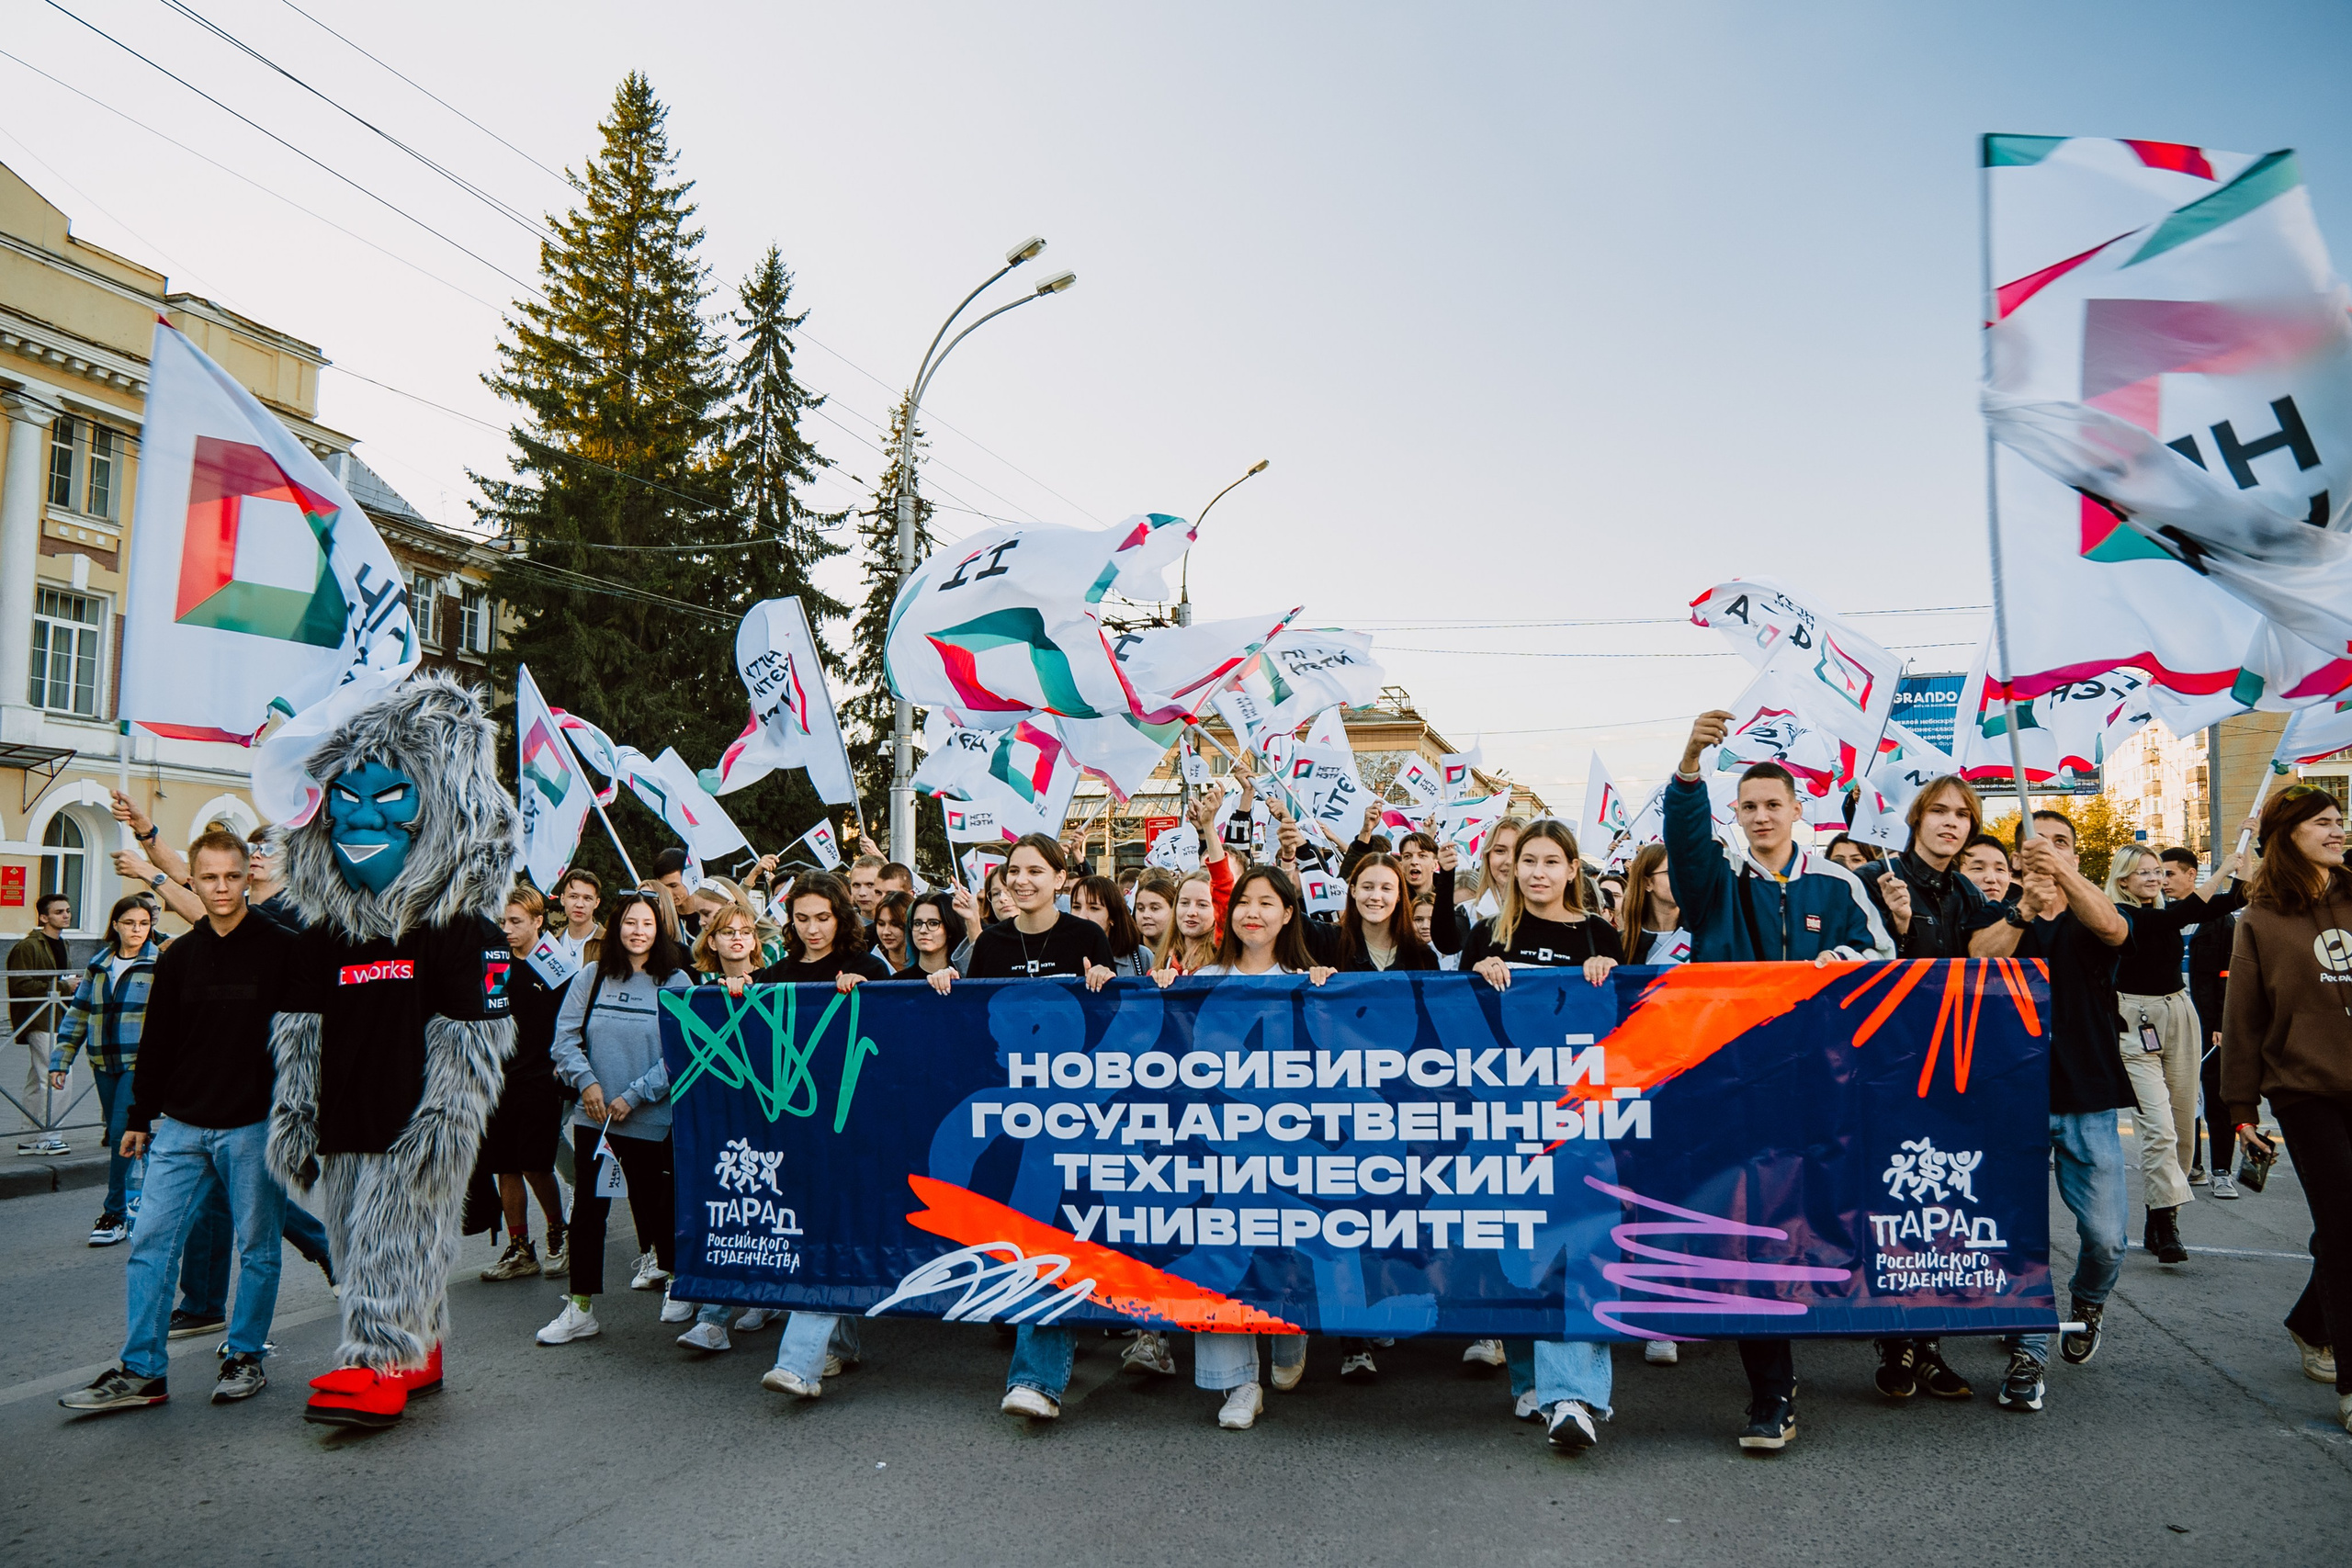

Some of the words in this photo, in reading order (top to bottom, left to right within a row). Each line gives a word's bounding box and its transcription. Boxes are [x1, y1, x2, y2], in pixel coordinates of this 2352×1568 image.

[1893, 691, 1958, 705] GRANDO
[1419, 782, 1436, 796] НЭТИ
[1422, 778, 1439, 792] НГТУ
[969, 818, 993, 827] НЭТИ
[485, 950, 511, 960] NSTU
[354, 960, 414, 984] works.
[546, 961, 562, 978] НЭТИ
[550, 957, 566, 974] НГТУ
[1008, 1033, 1605, 1089] НОВОСИБИРСКИЙ
[971, 1087, 1652, 1145] ГОСУДАРСТВЕННЫЙ
[1053, 1143, 1555, 1195] ТЕХНИЧЕСКИЙ
[706, 1197, 804, 1235] ПАРАД
[1061, 1204, 1548, 1250] УНИВЕРСИТЕТ
[1869, 1207, 2007, 1248] ПАРАД
